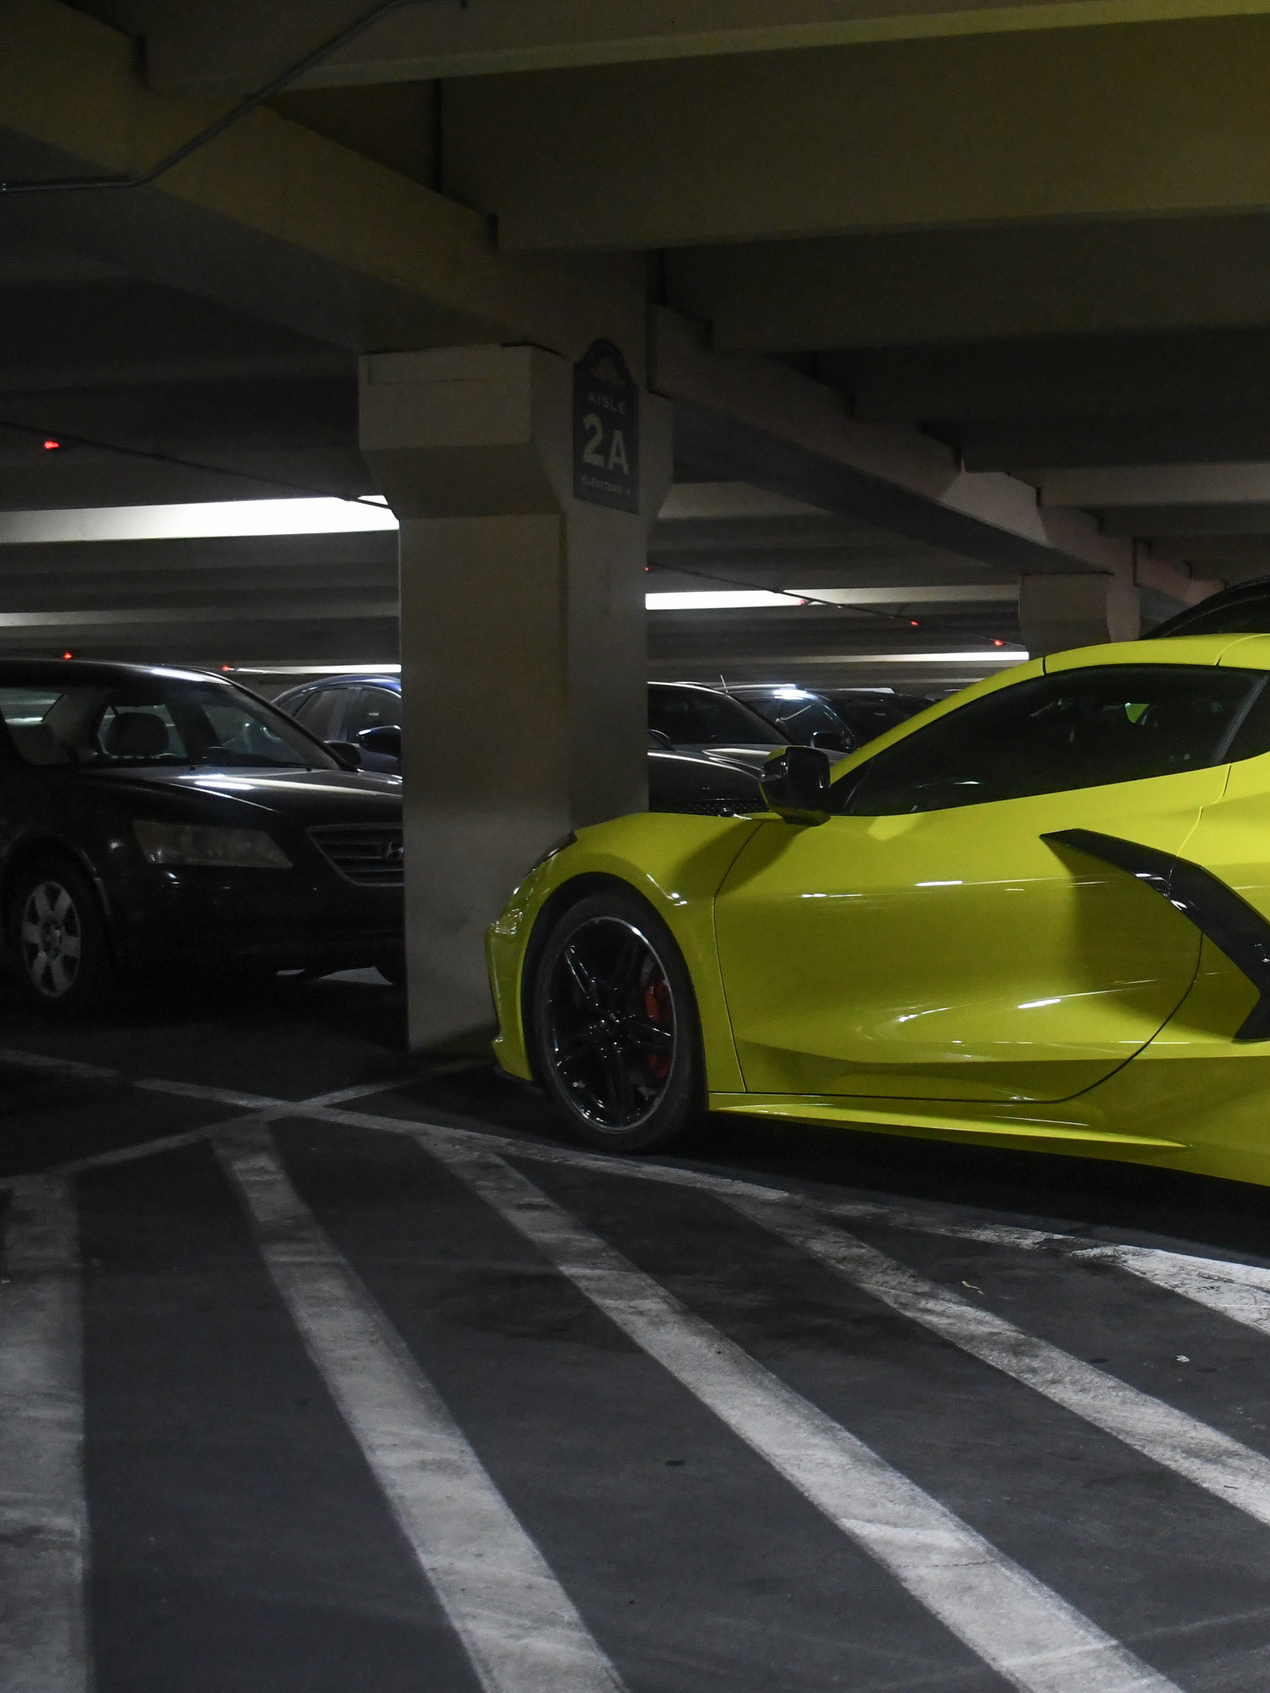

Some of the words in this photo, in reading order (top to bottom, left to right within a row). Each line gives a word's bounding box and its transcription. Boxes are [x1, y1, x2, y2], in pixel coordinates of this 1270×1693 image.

[587, 390, 626, 415] AISLE
[582, 412, 630, 476] 2A
[580, 475, 623, 495] ELEVATORS
